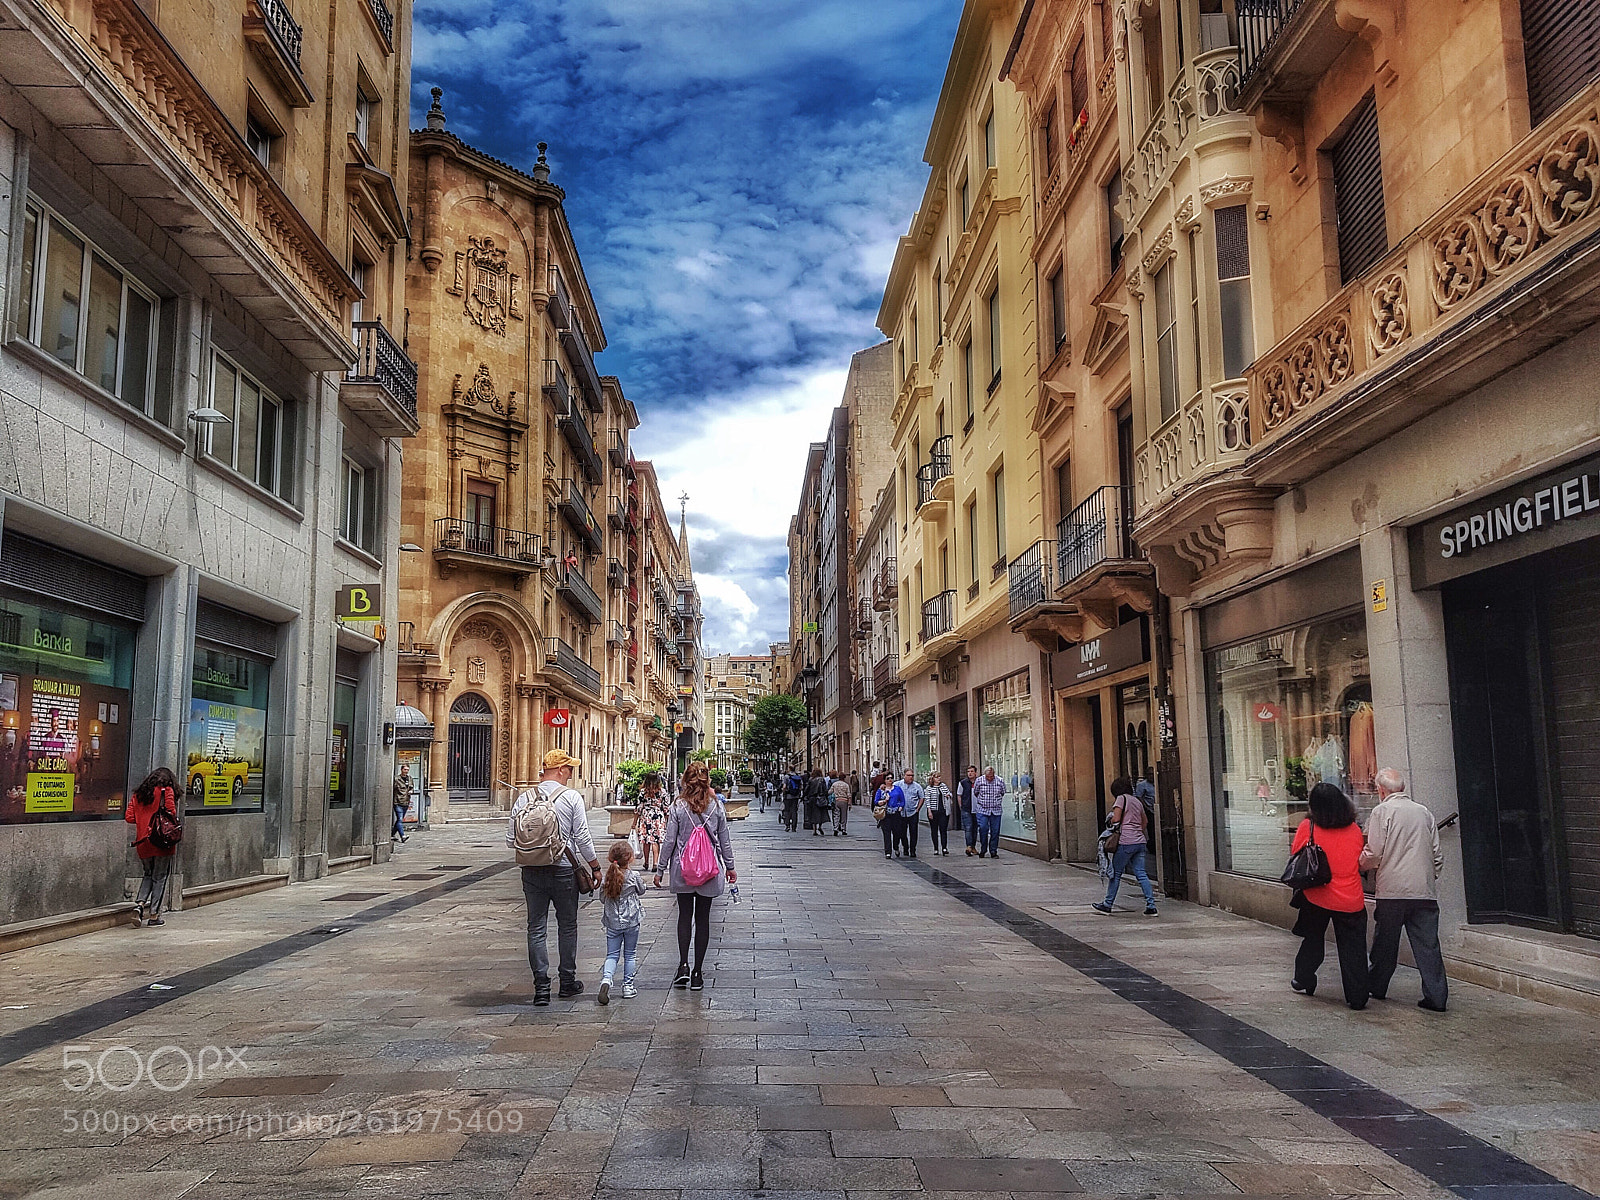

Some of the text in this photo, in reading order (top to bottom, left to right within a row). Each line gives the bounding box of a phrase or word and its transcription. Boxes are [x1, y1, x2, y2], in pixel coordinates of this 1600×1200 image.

[1440, 469, 1600, 559] SPRINGFIEL
[350, 588, 371, 613] B
[33, 628, 72, 653] Bankia
[1080, 639, 1100, 664] NYX
[33, 679, 58, 694] GRADUAR
[207, 667, 230, 684] Bankia
[37, 758, 68, 770] SALE CARO
